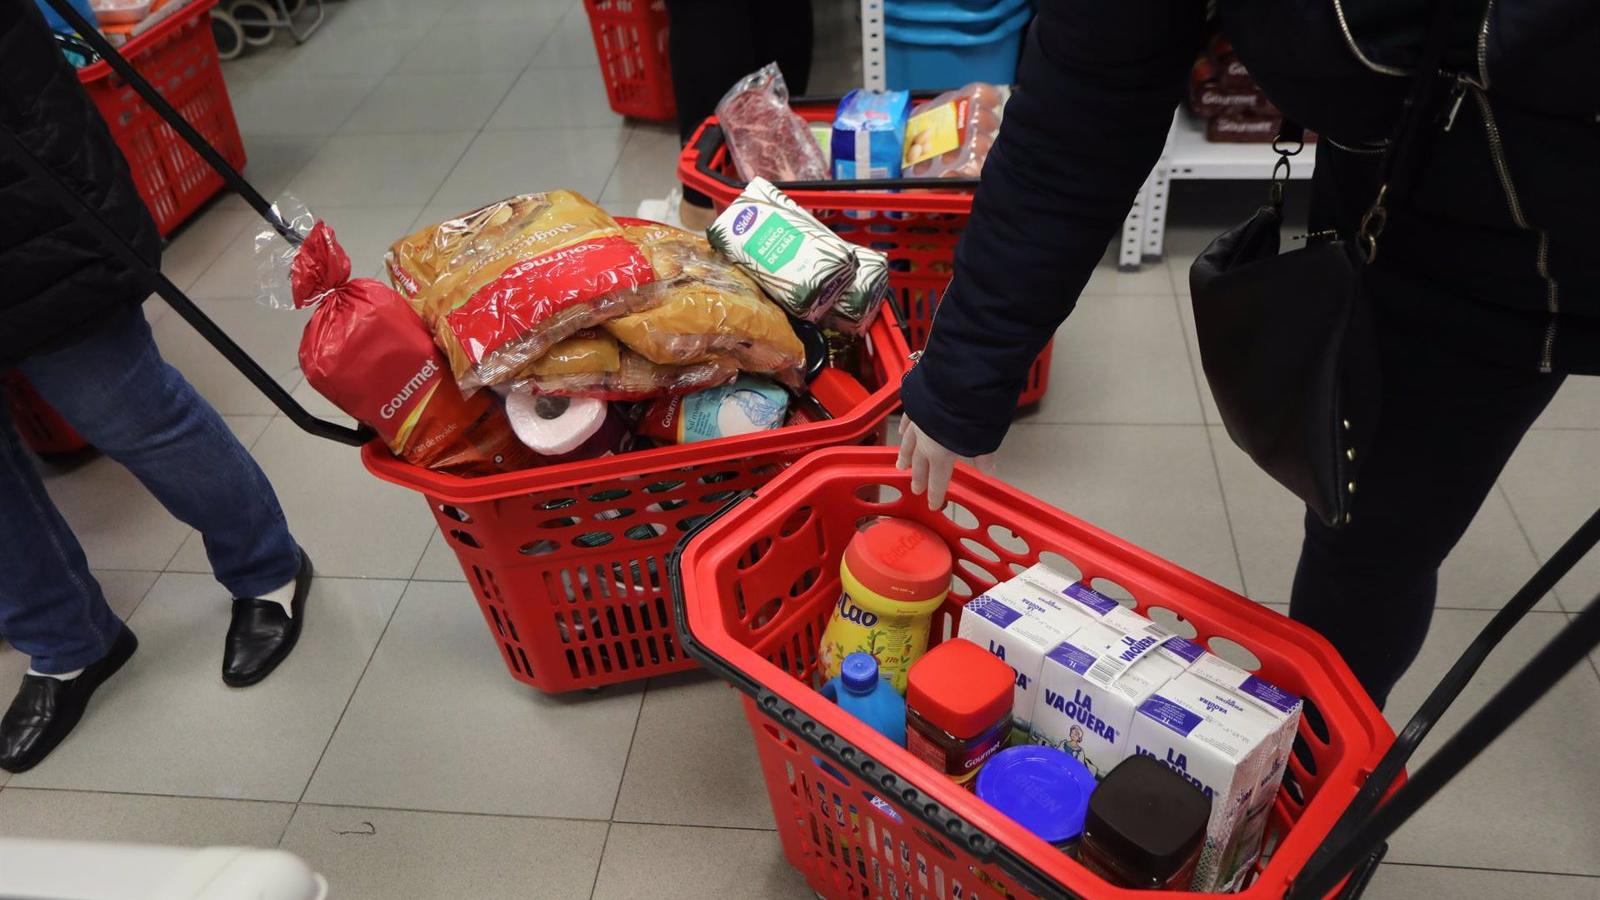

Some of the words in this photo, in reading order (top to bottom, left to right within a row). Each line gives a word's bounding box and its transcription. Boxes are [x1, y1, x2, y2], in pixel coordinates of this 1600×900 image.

[758, 226, 784, 256] BLANCO
[767, 251, 779, 264] DE
[380, 358, 439, 420] Gourmet
[662, 395, 678, 428] Gourm
[838, 591, 878, 627] Cao
[989, 640, 1006, 661] LA
[1120, 635, 1158, 662] VAQUERA
[1121, 635, 1137, 646] LA
[1075, 689, 1093, 712] LA
[1045, 688, 1116, 744] VAQUERA
[1168, 747, 1187, 771] LA
